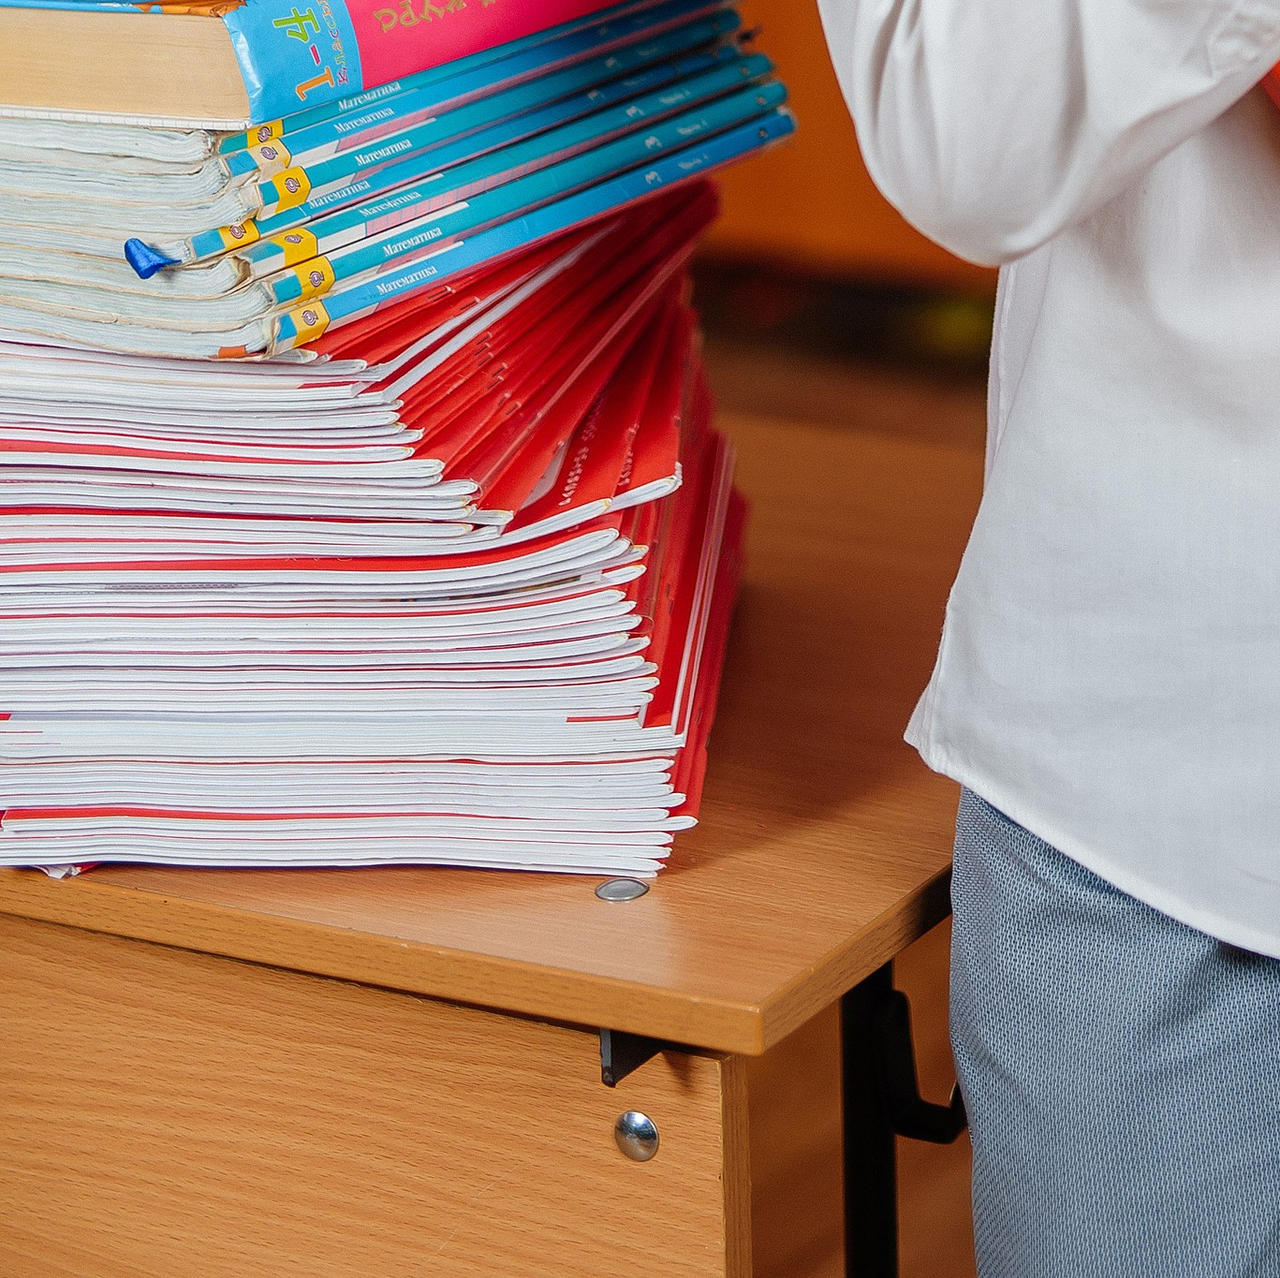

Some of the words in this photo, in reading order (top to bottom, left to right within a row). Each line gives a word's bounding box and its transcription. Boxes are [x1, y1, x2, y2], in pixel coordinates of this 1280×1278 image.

[272, 7, 335, 102] 1-4
[338, 81, 401, 112] Математика
[334, 107, 395, 134] Математика
[354, 138, 413, 166] Математика
[309, 180, 371, 209] Математика
[359, 191, 422, 217] Математика
[382, 226, 443, 257] Математика
[376, 265, 438, 296] Математика
